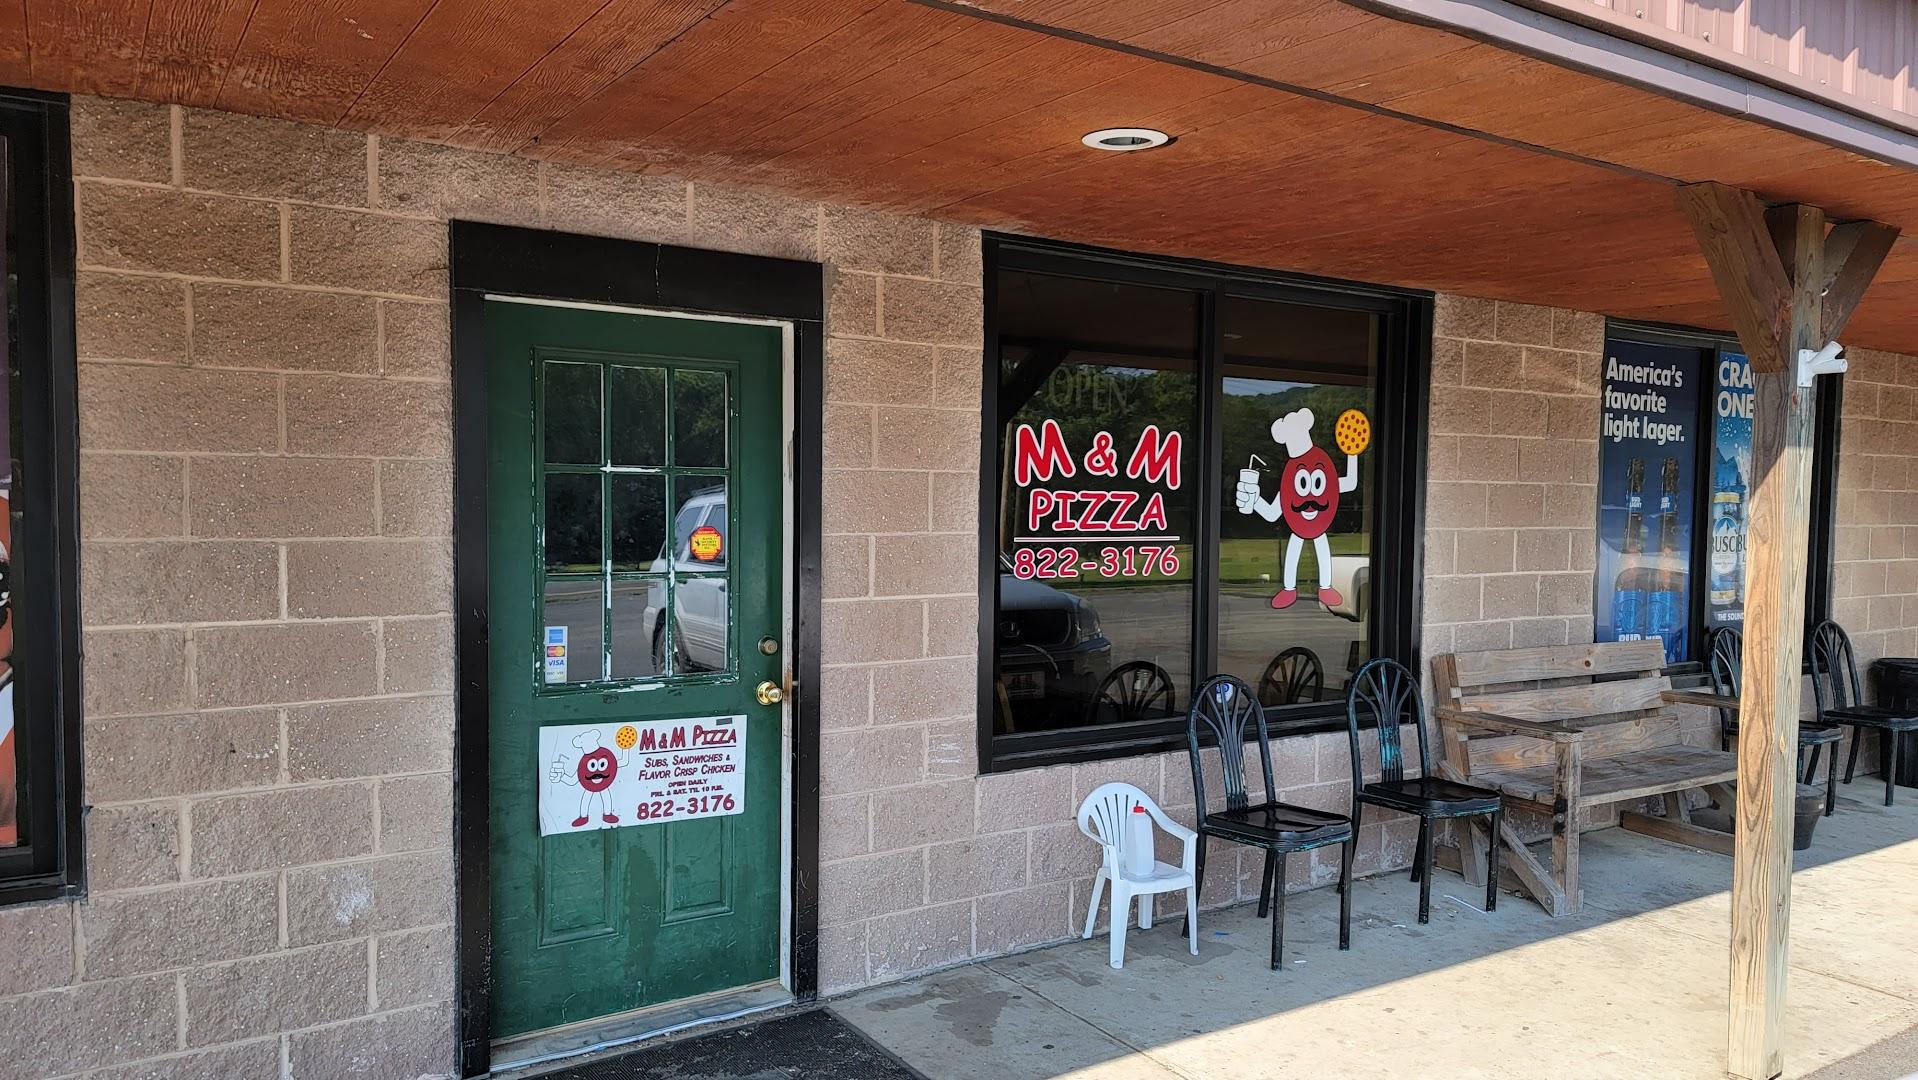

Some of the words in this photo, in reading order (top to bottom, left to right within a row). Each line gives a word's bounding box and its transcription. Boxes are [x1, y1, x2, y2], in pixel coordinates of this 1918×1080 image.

[1605, 357, 1683, 388] America's
[1718, 360, 1755, 389] CRA
[1047, 366, 1129, 418] OPEN
[1604, 385, 1667, 414] favorite
[1717, 391, 1755, 419] ONE
[1603, 412, 1640, 443] light
[1642, 416, 1685, 446] lager.
[1014, 418, 1077, 487] M
[1083, 430, 1118, 477] &
[1126, 424, 1182, 491] M
[1028, 487, 1168, 532] PIZZA
[1013, 545, 1180, 579] 822-3176
[548, 659, 565, 667] VISA
[693, 725, 736, 746] PIZZA
[638, 769, 671, 781] FLAVOR
[673, 766, 698, 778] CRISP
[701, 763, 737, 775] CHICKEN
[644, 757, 669, 769] SUBS,
[672, 753, 723, 766] SANDWICHES
[668, 780, 687, 788] OPEN
[688, 778, 708, 786] DAILY
[636, 793, 736, 820] 822-3176
